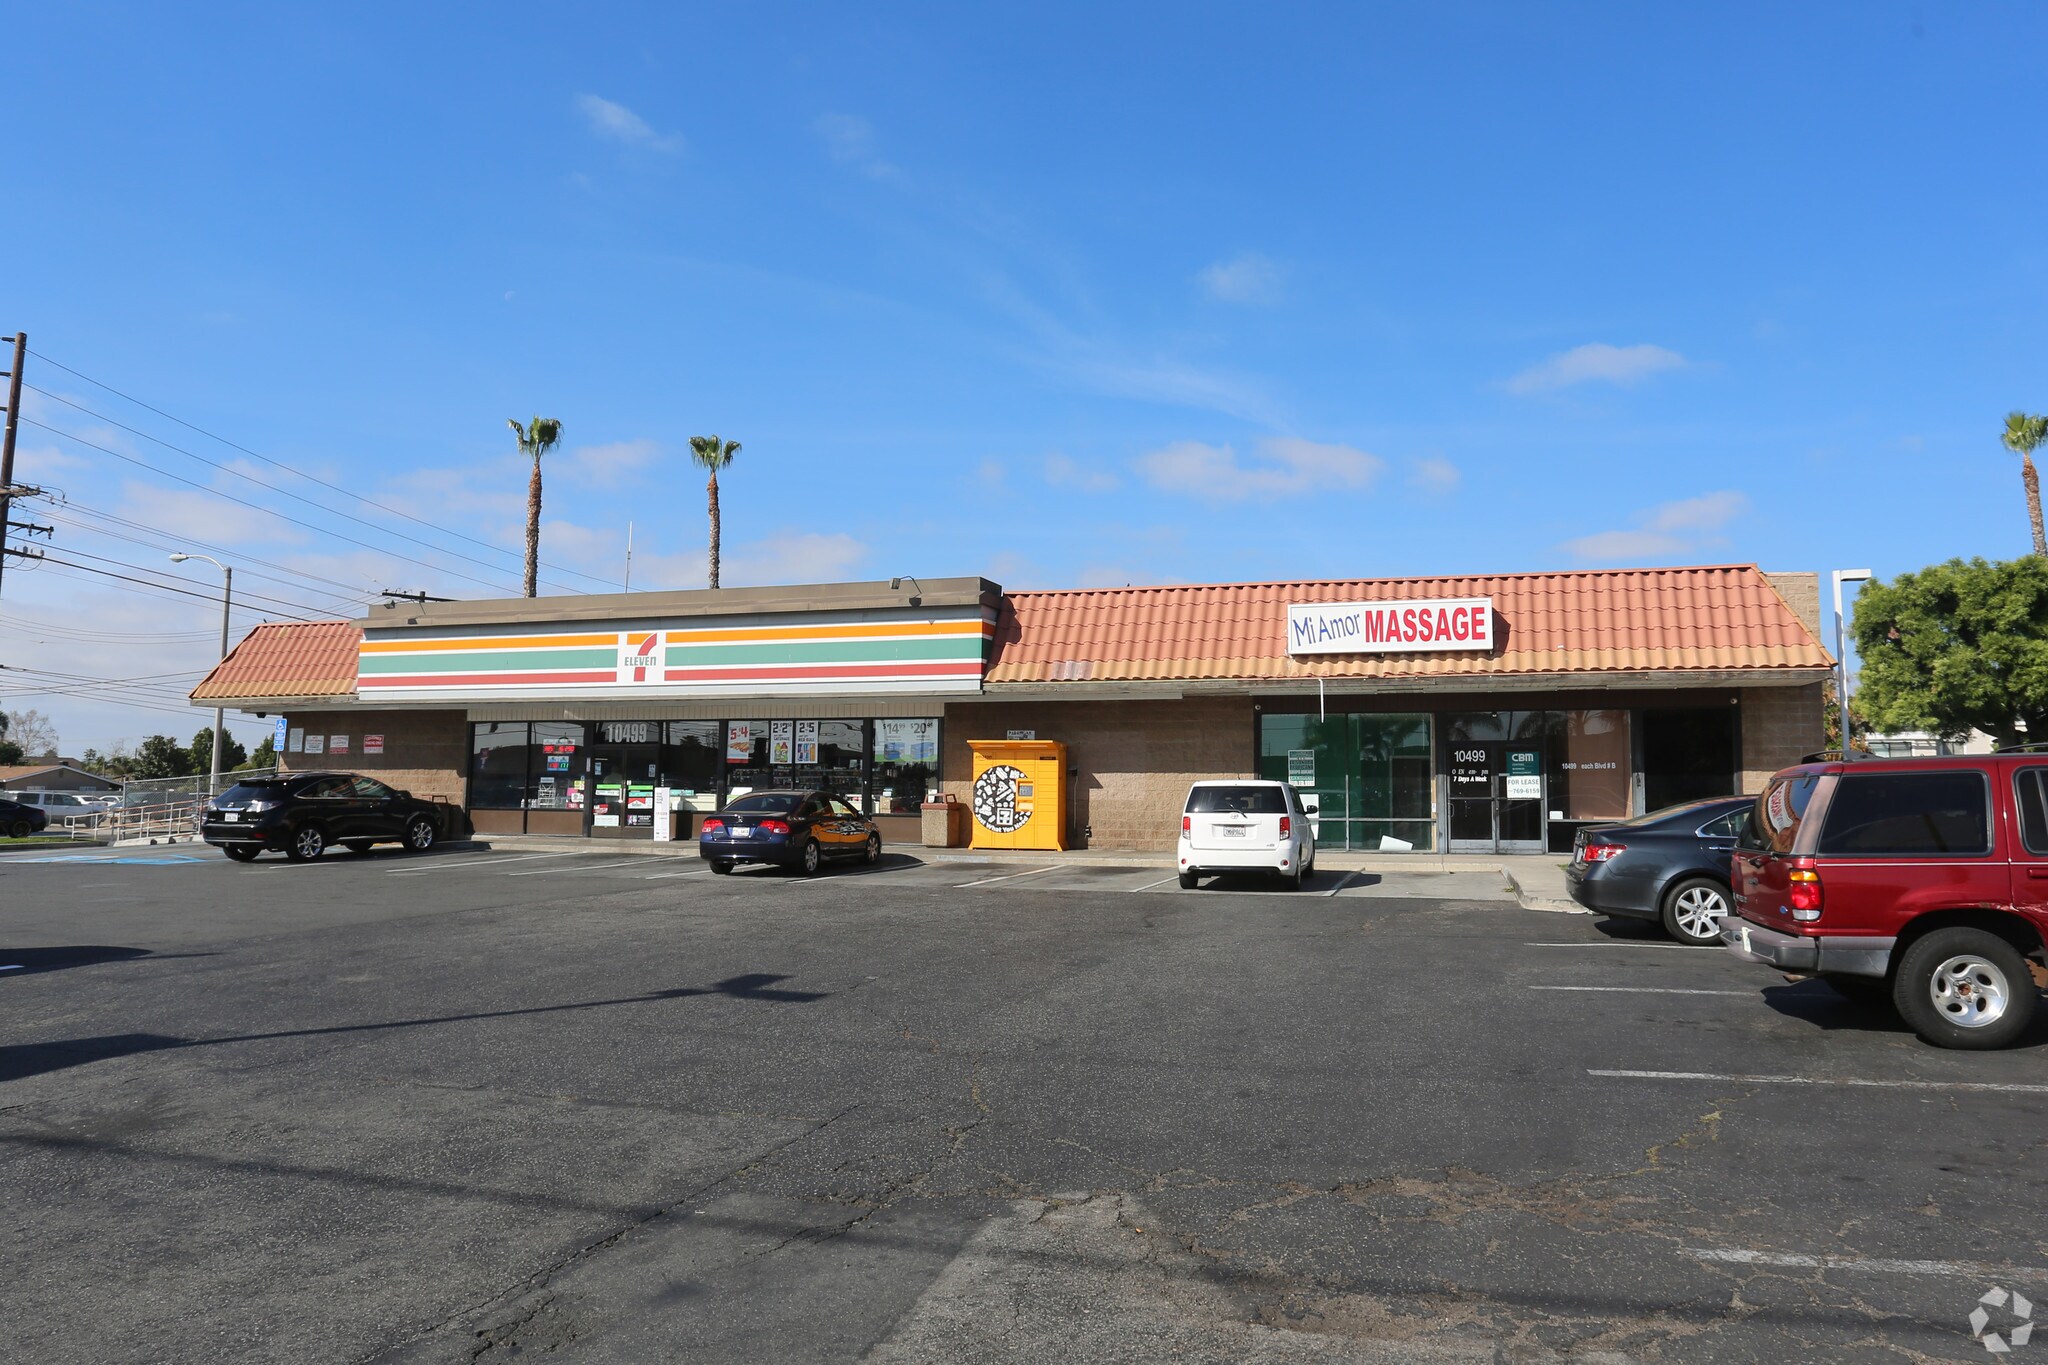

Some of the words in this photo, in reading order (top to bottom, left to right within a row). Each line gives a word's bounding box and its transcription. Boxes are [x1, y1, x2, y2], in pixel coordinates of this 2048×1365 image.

[1293, 616, 1316, 646] Mi
[1318, 613, 1360, 642] Amor
[1365, 606, 1486, 643] MASSAGE
[607, 723, 647, 743] 10499
[772, 723, 779, 733] 2
[799, 722, 806, 733] 2
[1454, 750, 1486, 762] 10499
[1561, 762, 1577, 770] 10499
[986, 822, 1002, 833] What
